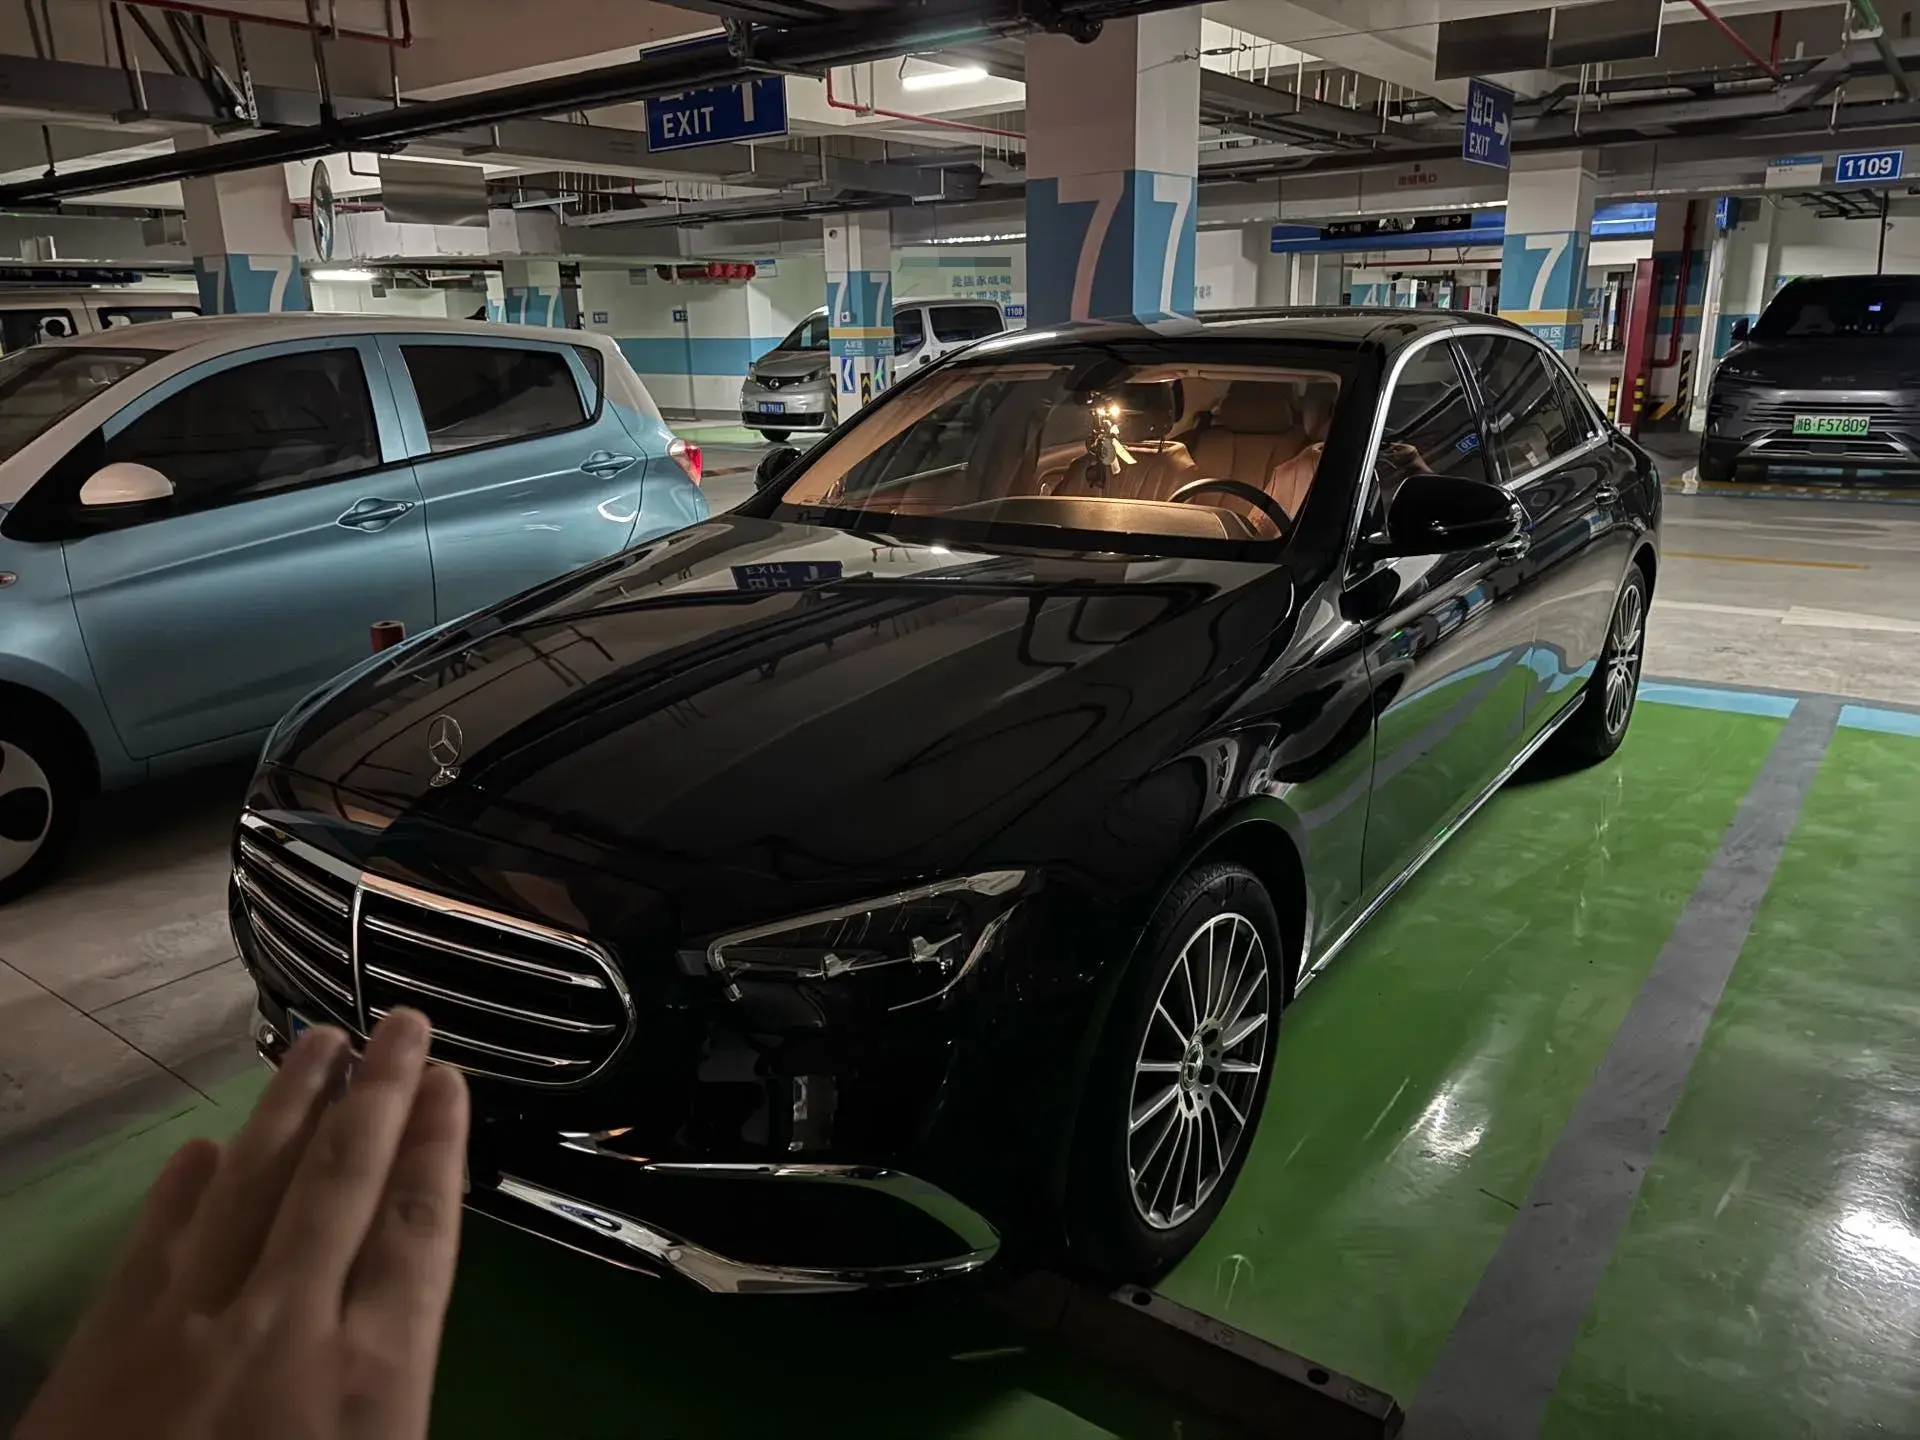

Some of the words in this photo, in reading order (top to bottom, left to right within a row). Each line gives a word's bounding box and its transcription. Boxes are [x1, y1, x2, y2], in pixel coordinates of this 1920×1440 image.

[662, 107, 714, 139] EXIT
[1471, 90, 1494, 127] 出口
[1470, 132, 1491, 157] EXIT
[1845, 156, 1893, 177] 1109
[1057, 172, 1125, 322] 7
[1153, 174, 1193, 314] 7
[248, 256, 293, 313] 7
[1525, 234, 1569, 311] 7
[539, 288, 559, 328] 7
[827, 272, 848, 327] 7
[870, 272, 889, 327] 7
[1006, 307, 1023, 317] 1108
[1588, 287, 1600, 309] 4
